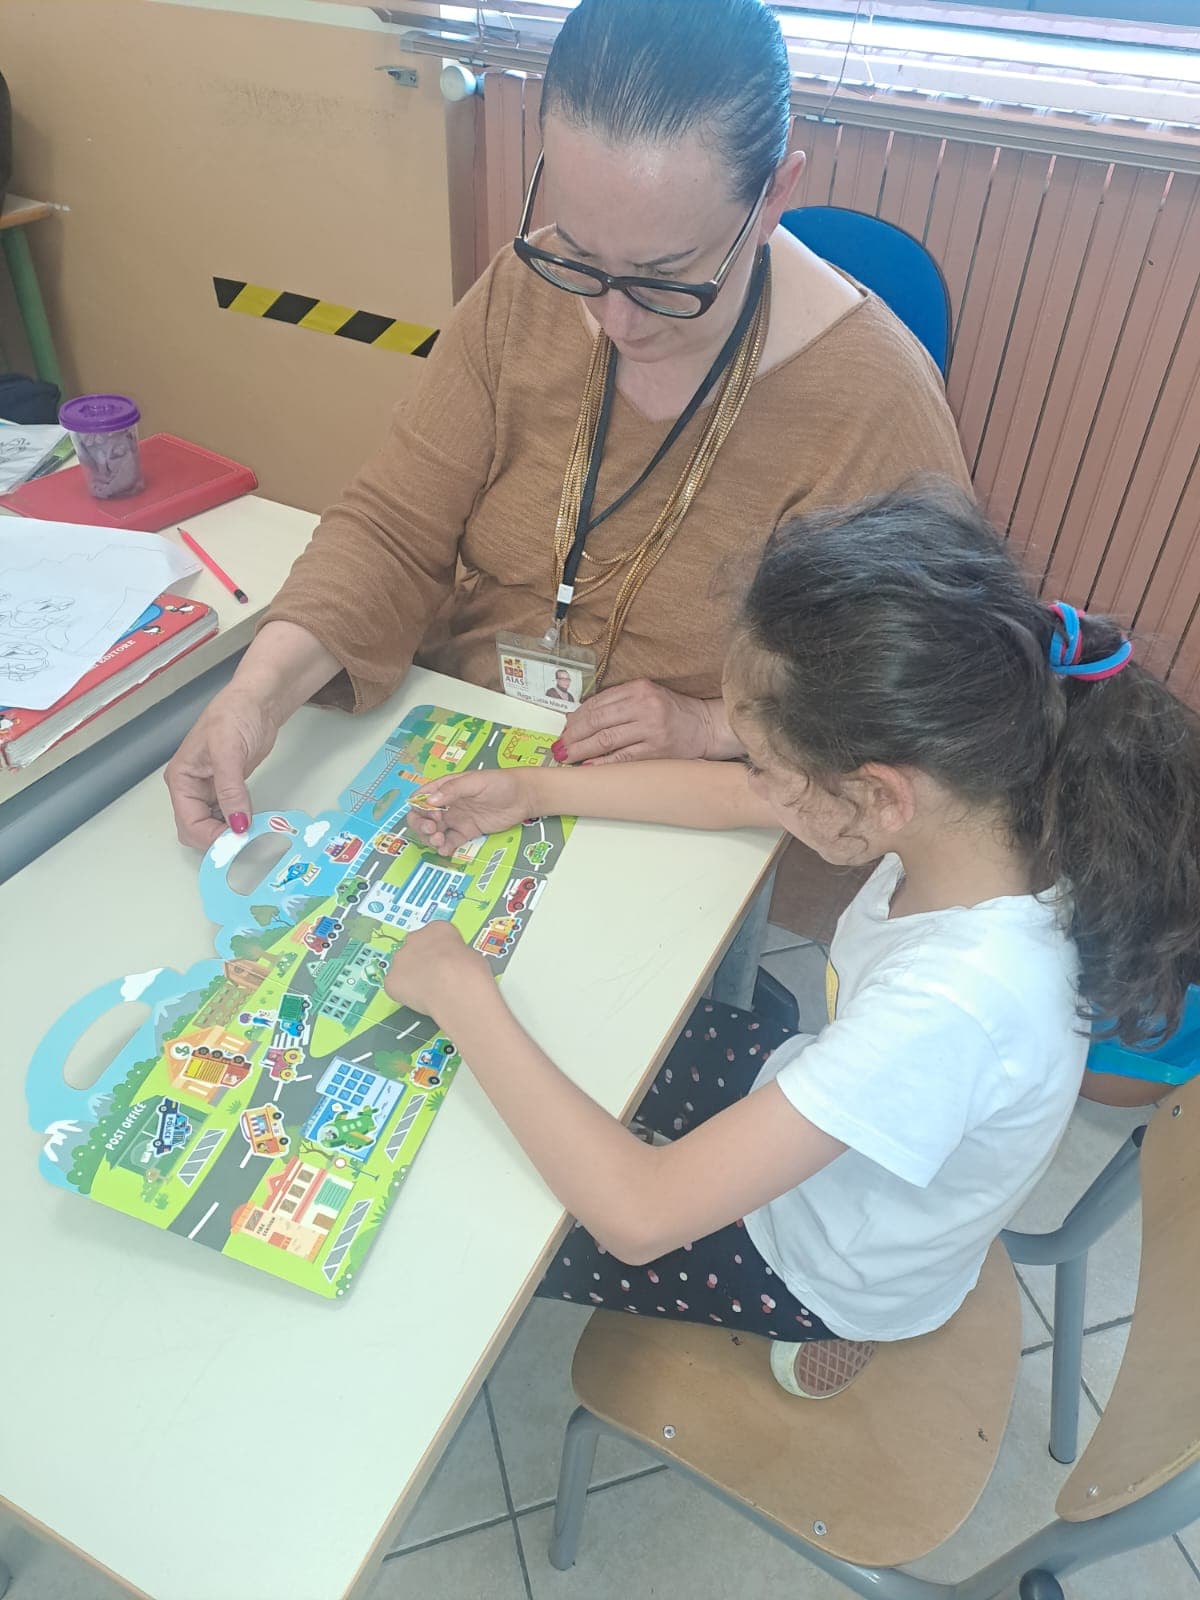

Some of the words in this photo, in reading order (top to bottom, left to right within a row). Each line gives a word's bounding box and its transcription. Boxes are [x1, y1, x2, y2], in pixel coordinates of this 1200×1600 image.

[505, 676, 525, 686] AIAS
[105, 1129, 127, 1151] POST
[122, 1102, 147, 1129] OFFICE
[164, 1117, 174, 1138] POLICE
